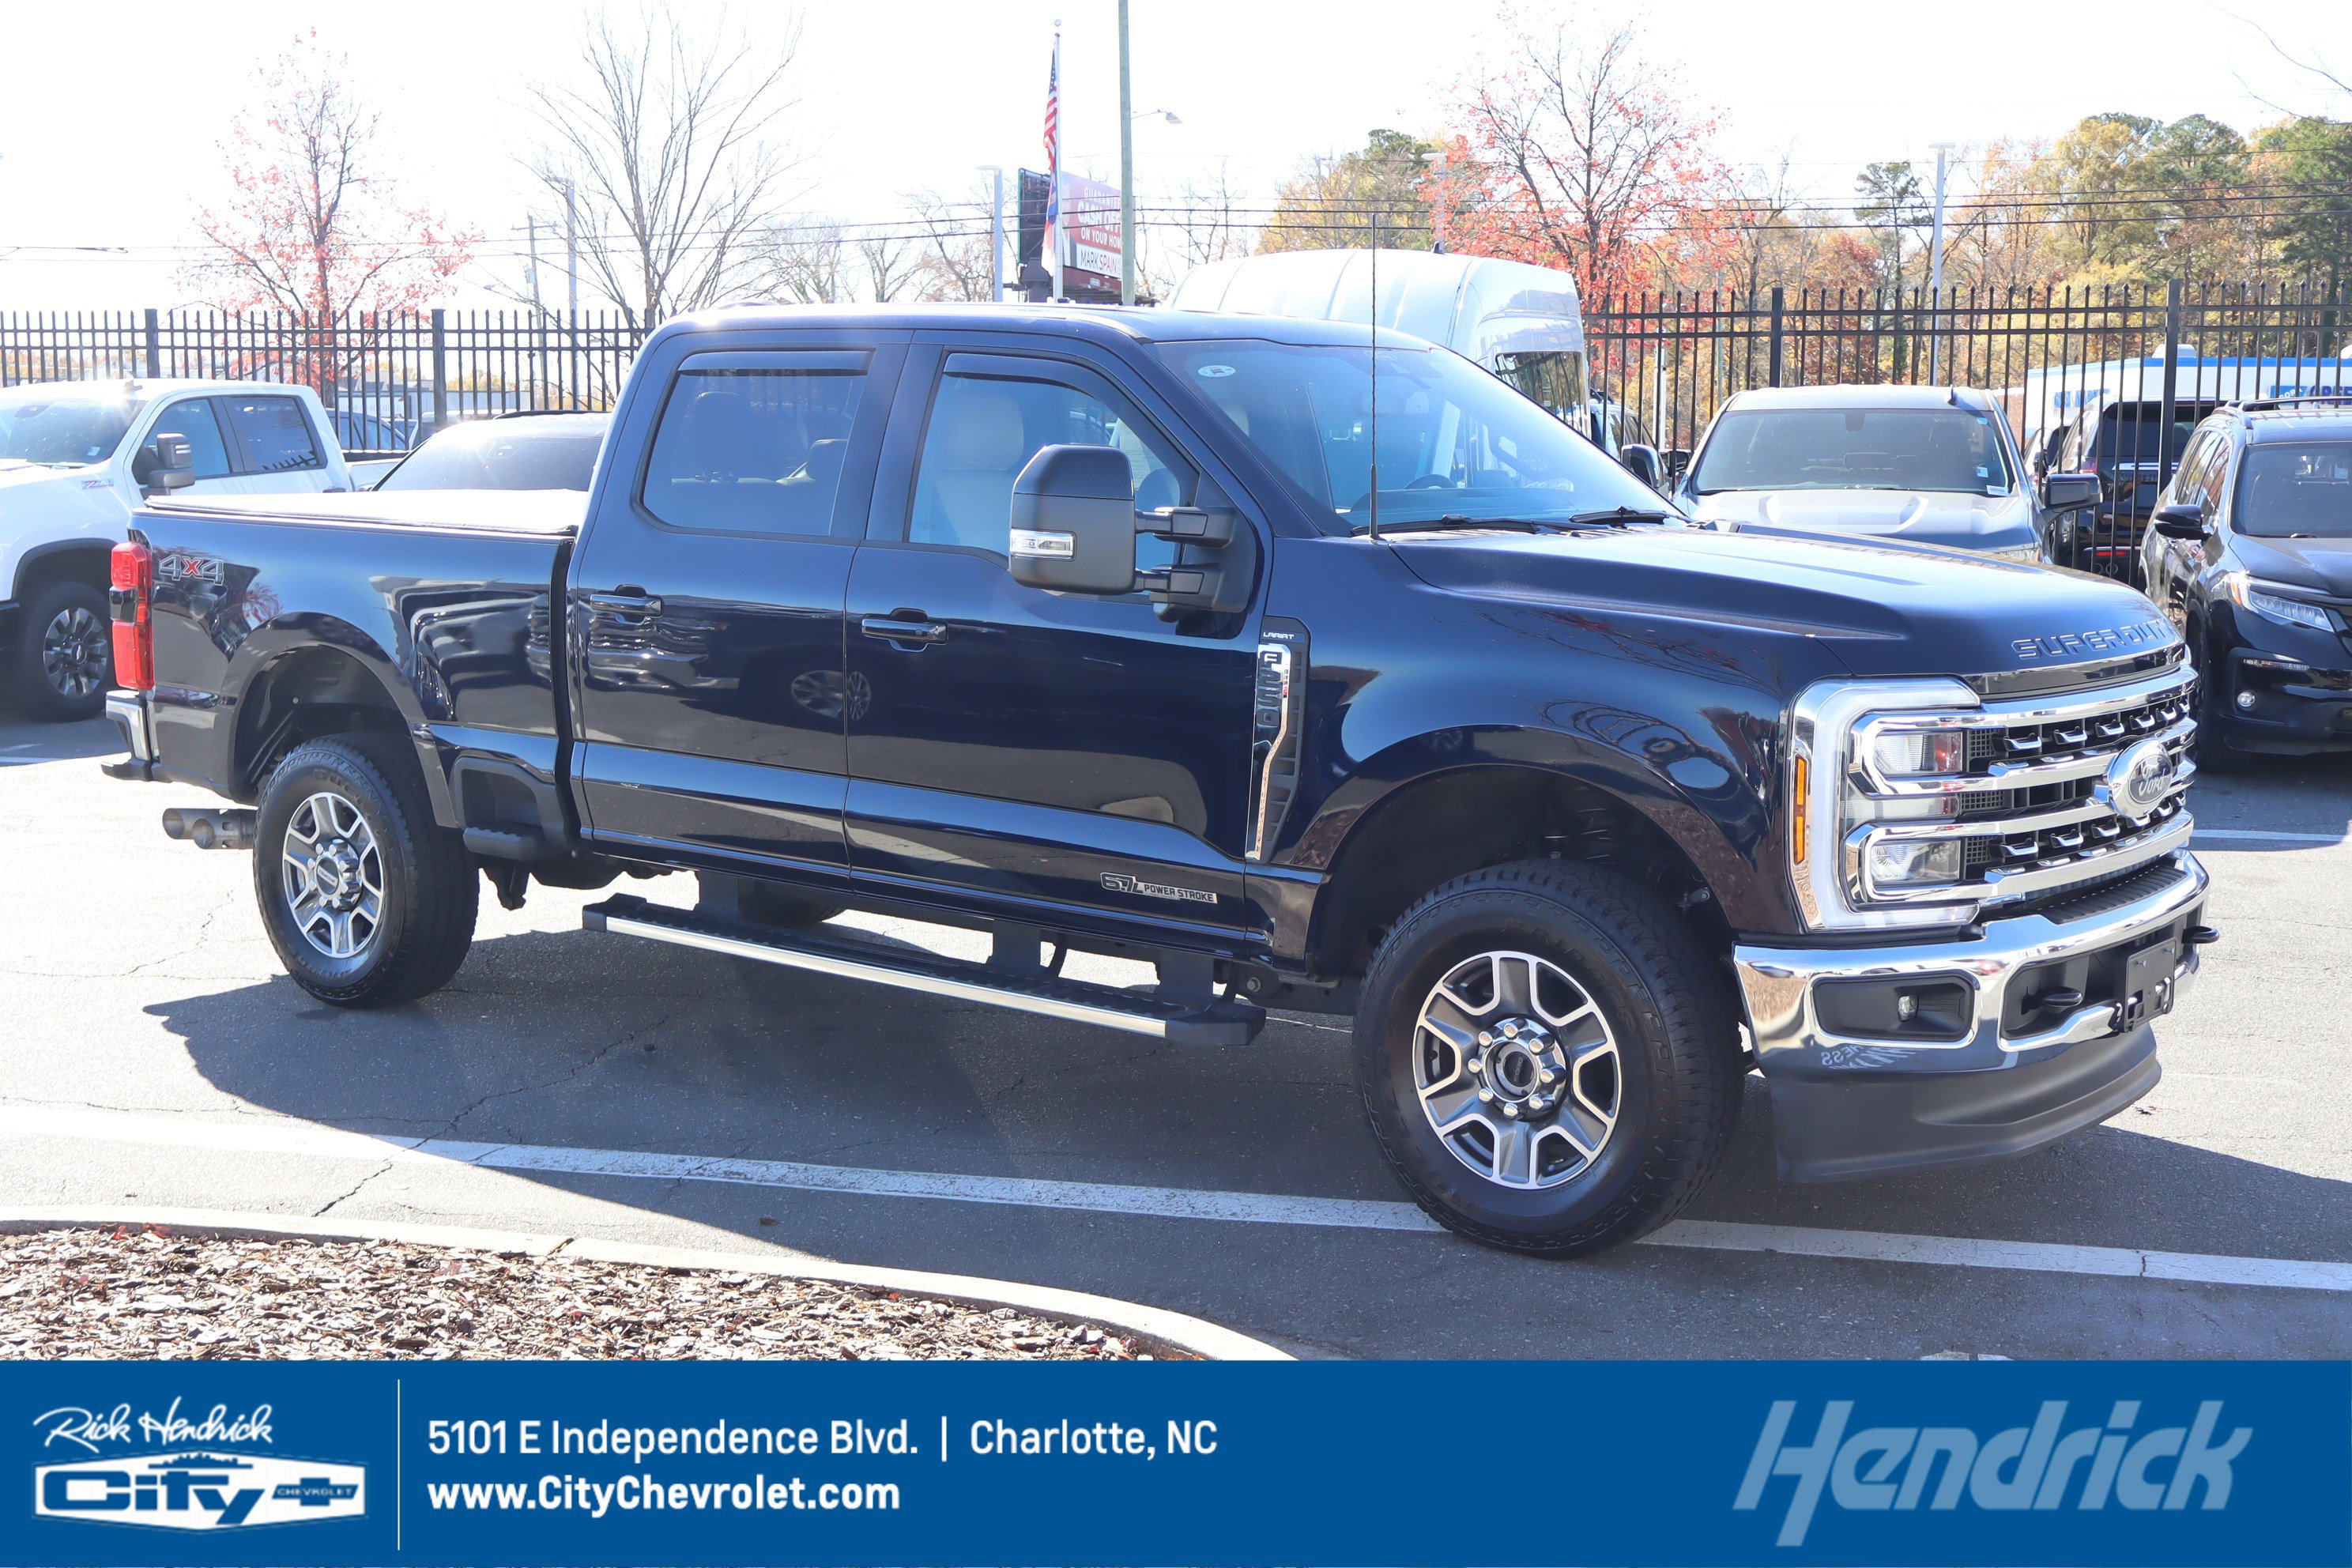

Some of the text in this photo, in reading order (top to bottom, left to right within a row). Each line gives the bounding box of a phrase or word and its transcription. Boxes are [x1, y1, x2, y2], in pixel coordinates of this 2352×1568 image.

[1077, 201, 1102, 228] CASH
[1081, 227, 1091, 240] ON
[1091, 229, 1108, 245] YOUR
[1080, 249, 1099, 269] MARK
[1099, 254, 1118, 273] SPAIN
[1263, 631, 1295, 640] LARIAT
[2011, 629, 2126, 660] SUPER
[1144, 884, 1175, 896] POWER
[1178, 888, 1215, 903] STROKE
